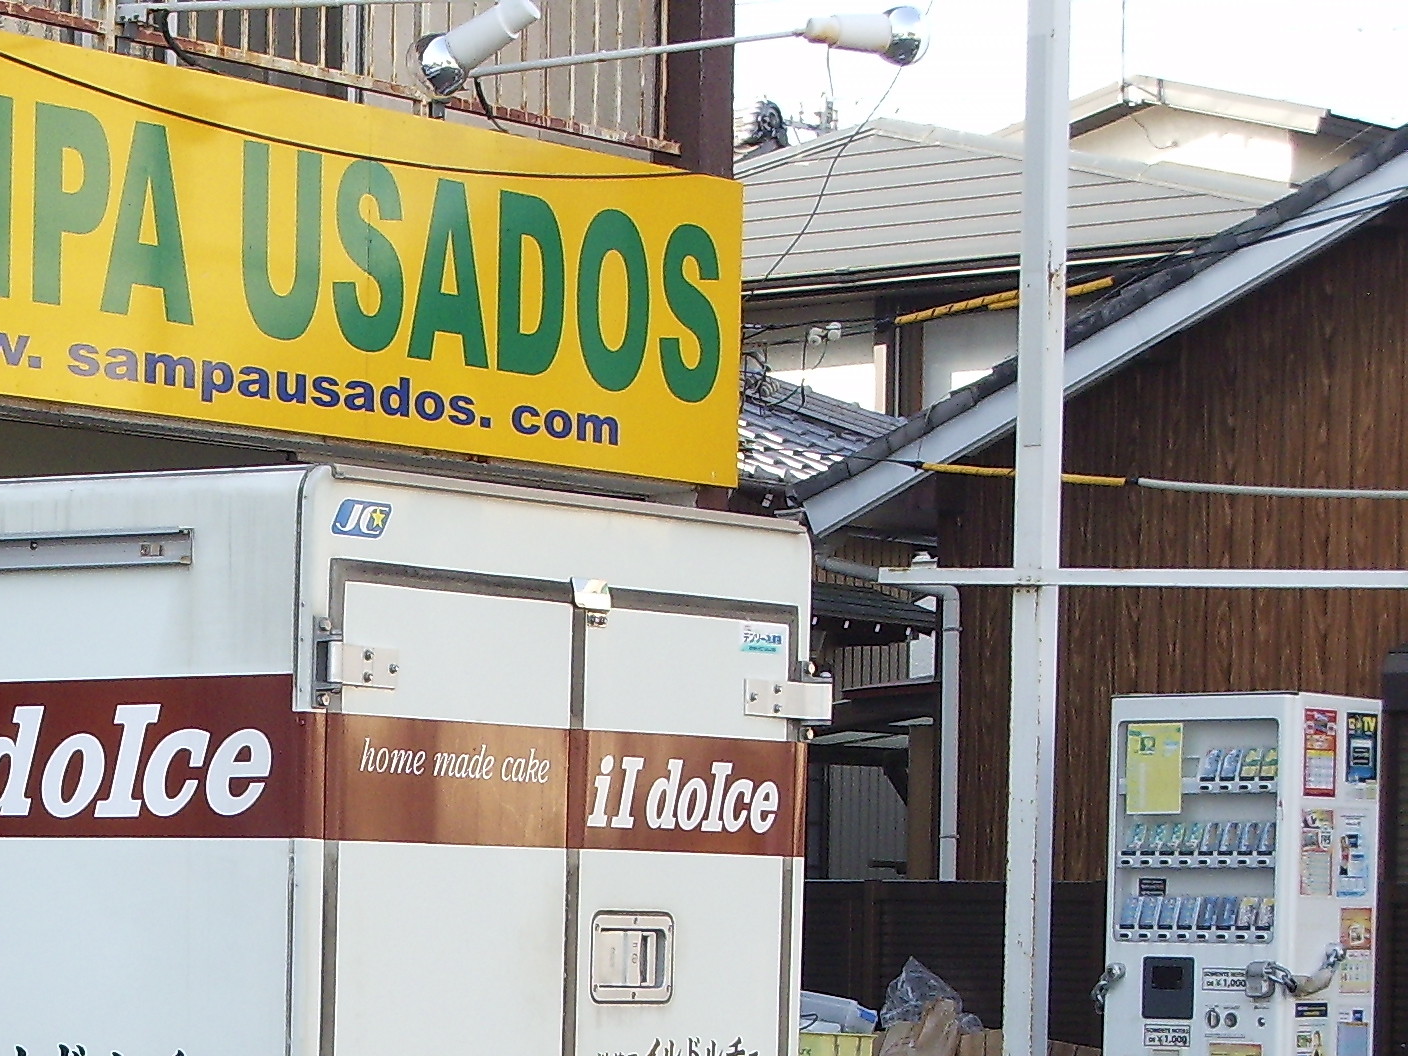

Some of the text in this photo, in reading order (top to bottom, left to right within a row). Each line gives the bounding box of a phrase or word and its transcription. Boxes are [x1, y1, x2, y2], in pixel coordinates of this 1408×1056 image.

[241, 139, 721, 404] USADOS
[67, 341, 493, 428] sampausados.
[511, 402, 620, 446] com
[358, 737, 550, 783] home made cake
